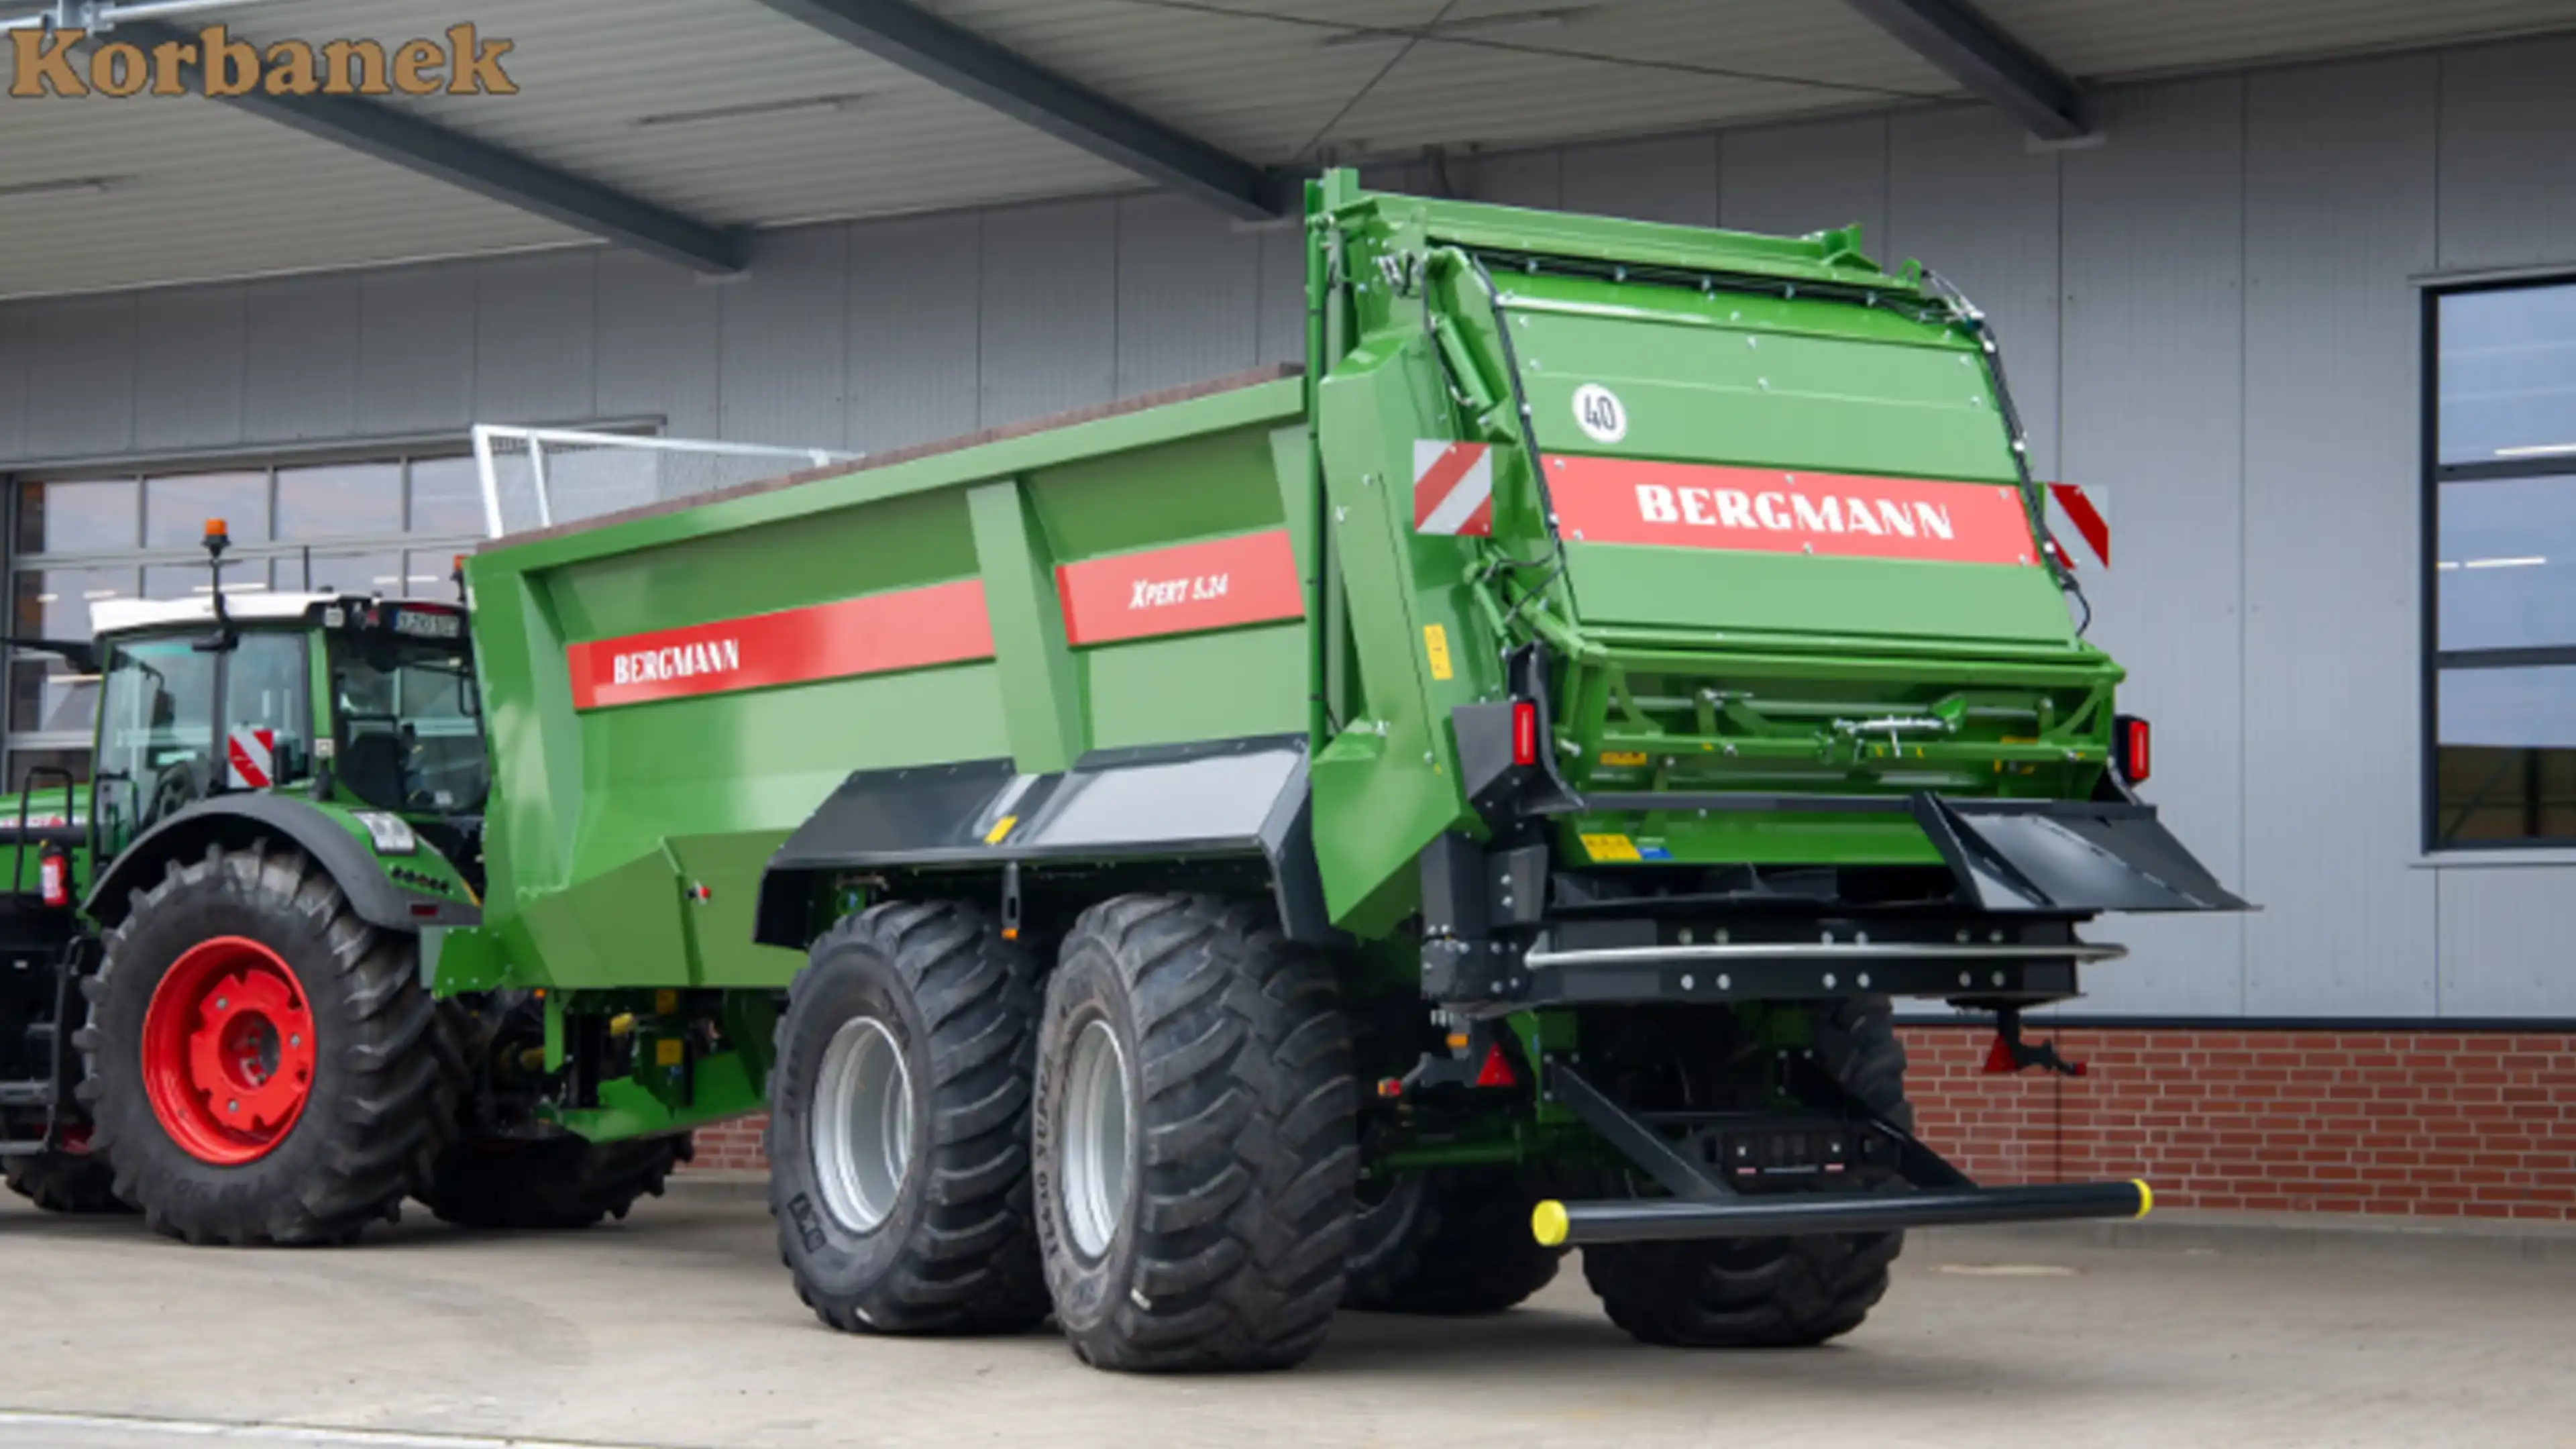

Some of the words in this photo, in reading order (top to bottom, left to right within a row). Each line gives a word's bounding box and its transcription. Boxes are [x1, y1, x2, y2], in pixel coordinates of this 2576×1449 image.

[1583, 394, 1618, 431] 40
[1635, 483, 1955, 539] BERGMANN
[614, 639, 739, 685] BERGMANN
